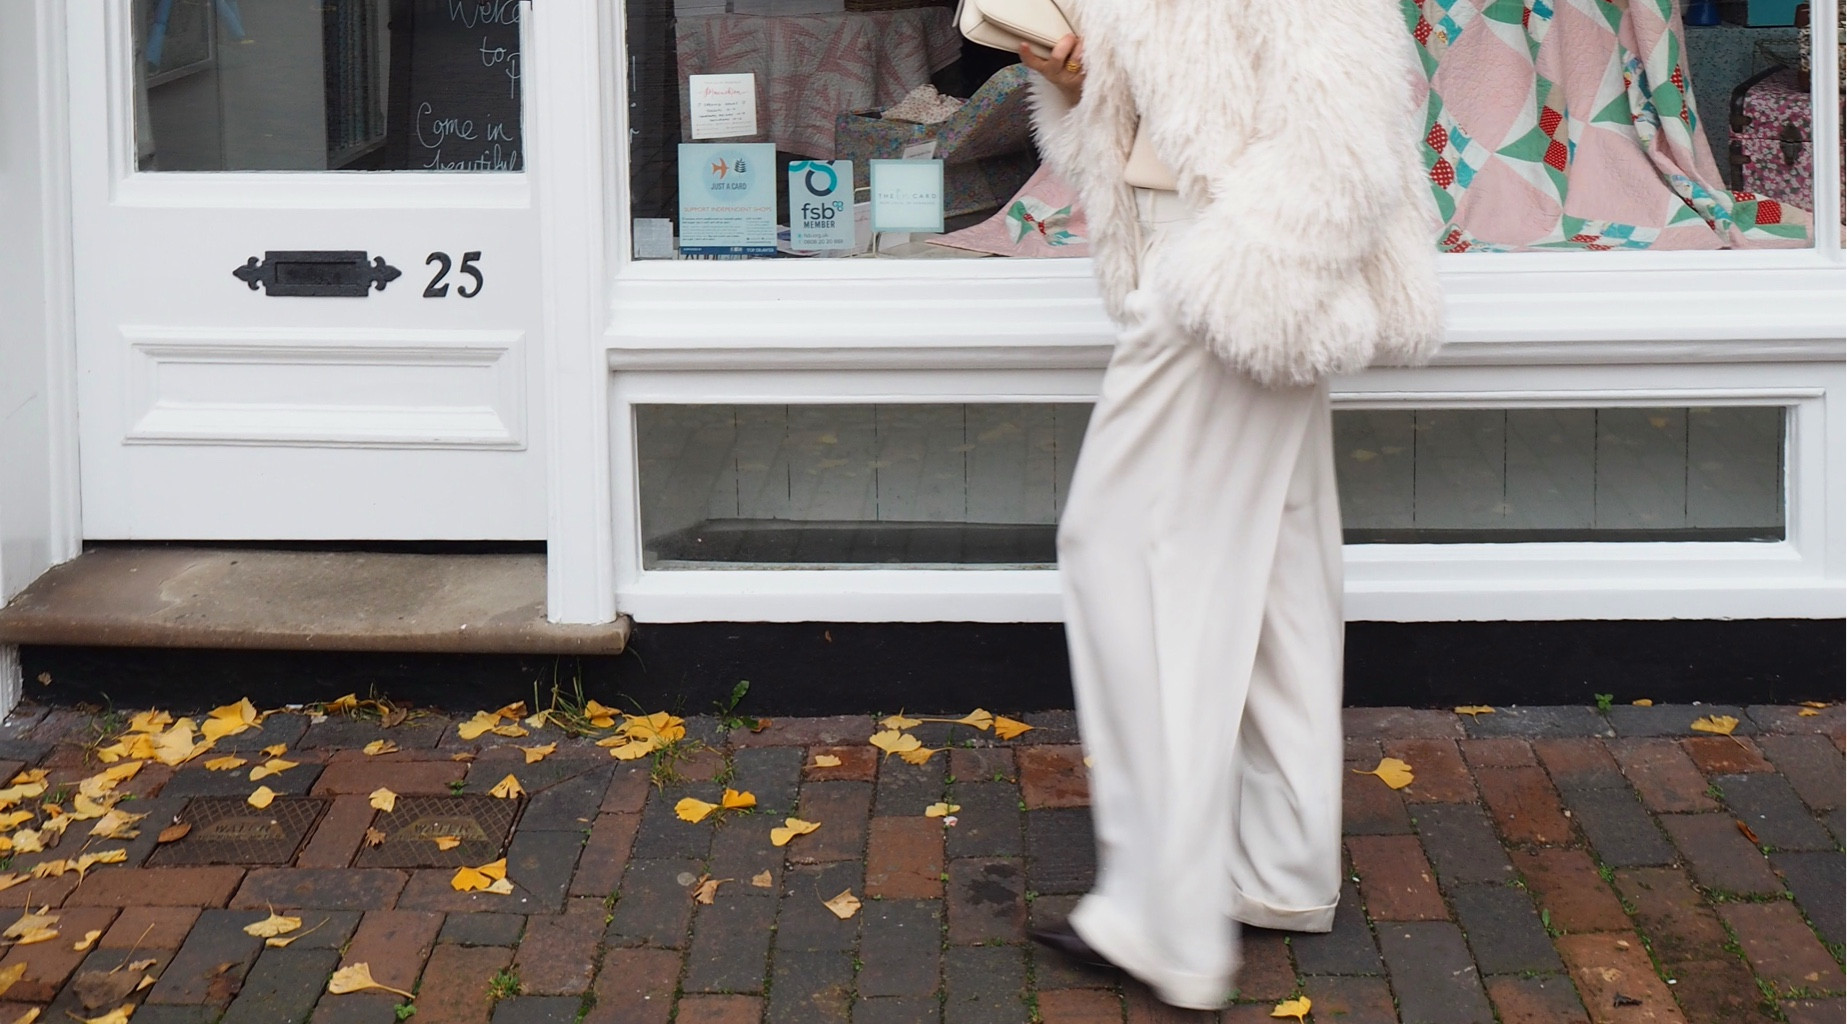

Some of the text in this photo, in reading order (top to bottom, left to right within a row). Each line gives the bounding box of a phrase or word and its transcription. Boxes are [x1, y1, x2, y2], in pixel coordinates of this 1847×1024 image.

[479, 36, 507, 67] to
[416, 102, 513, 148] Come in
[711, 182, 747, 190] JUST A CARD
[801, 202, 834, 219] fsb
[422, 250, 484, 298] 25
